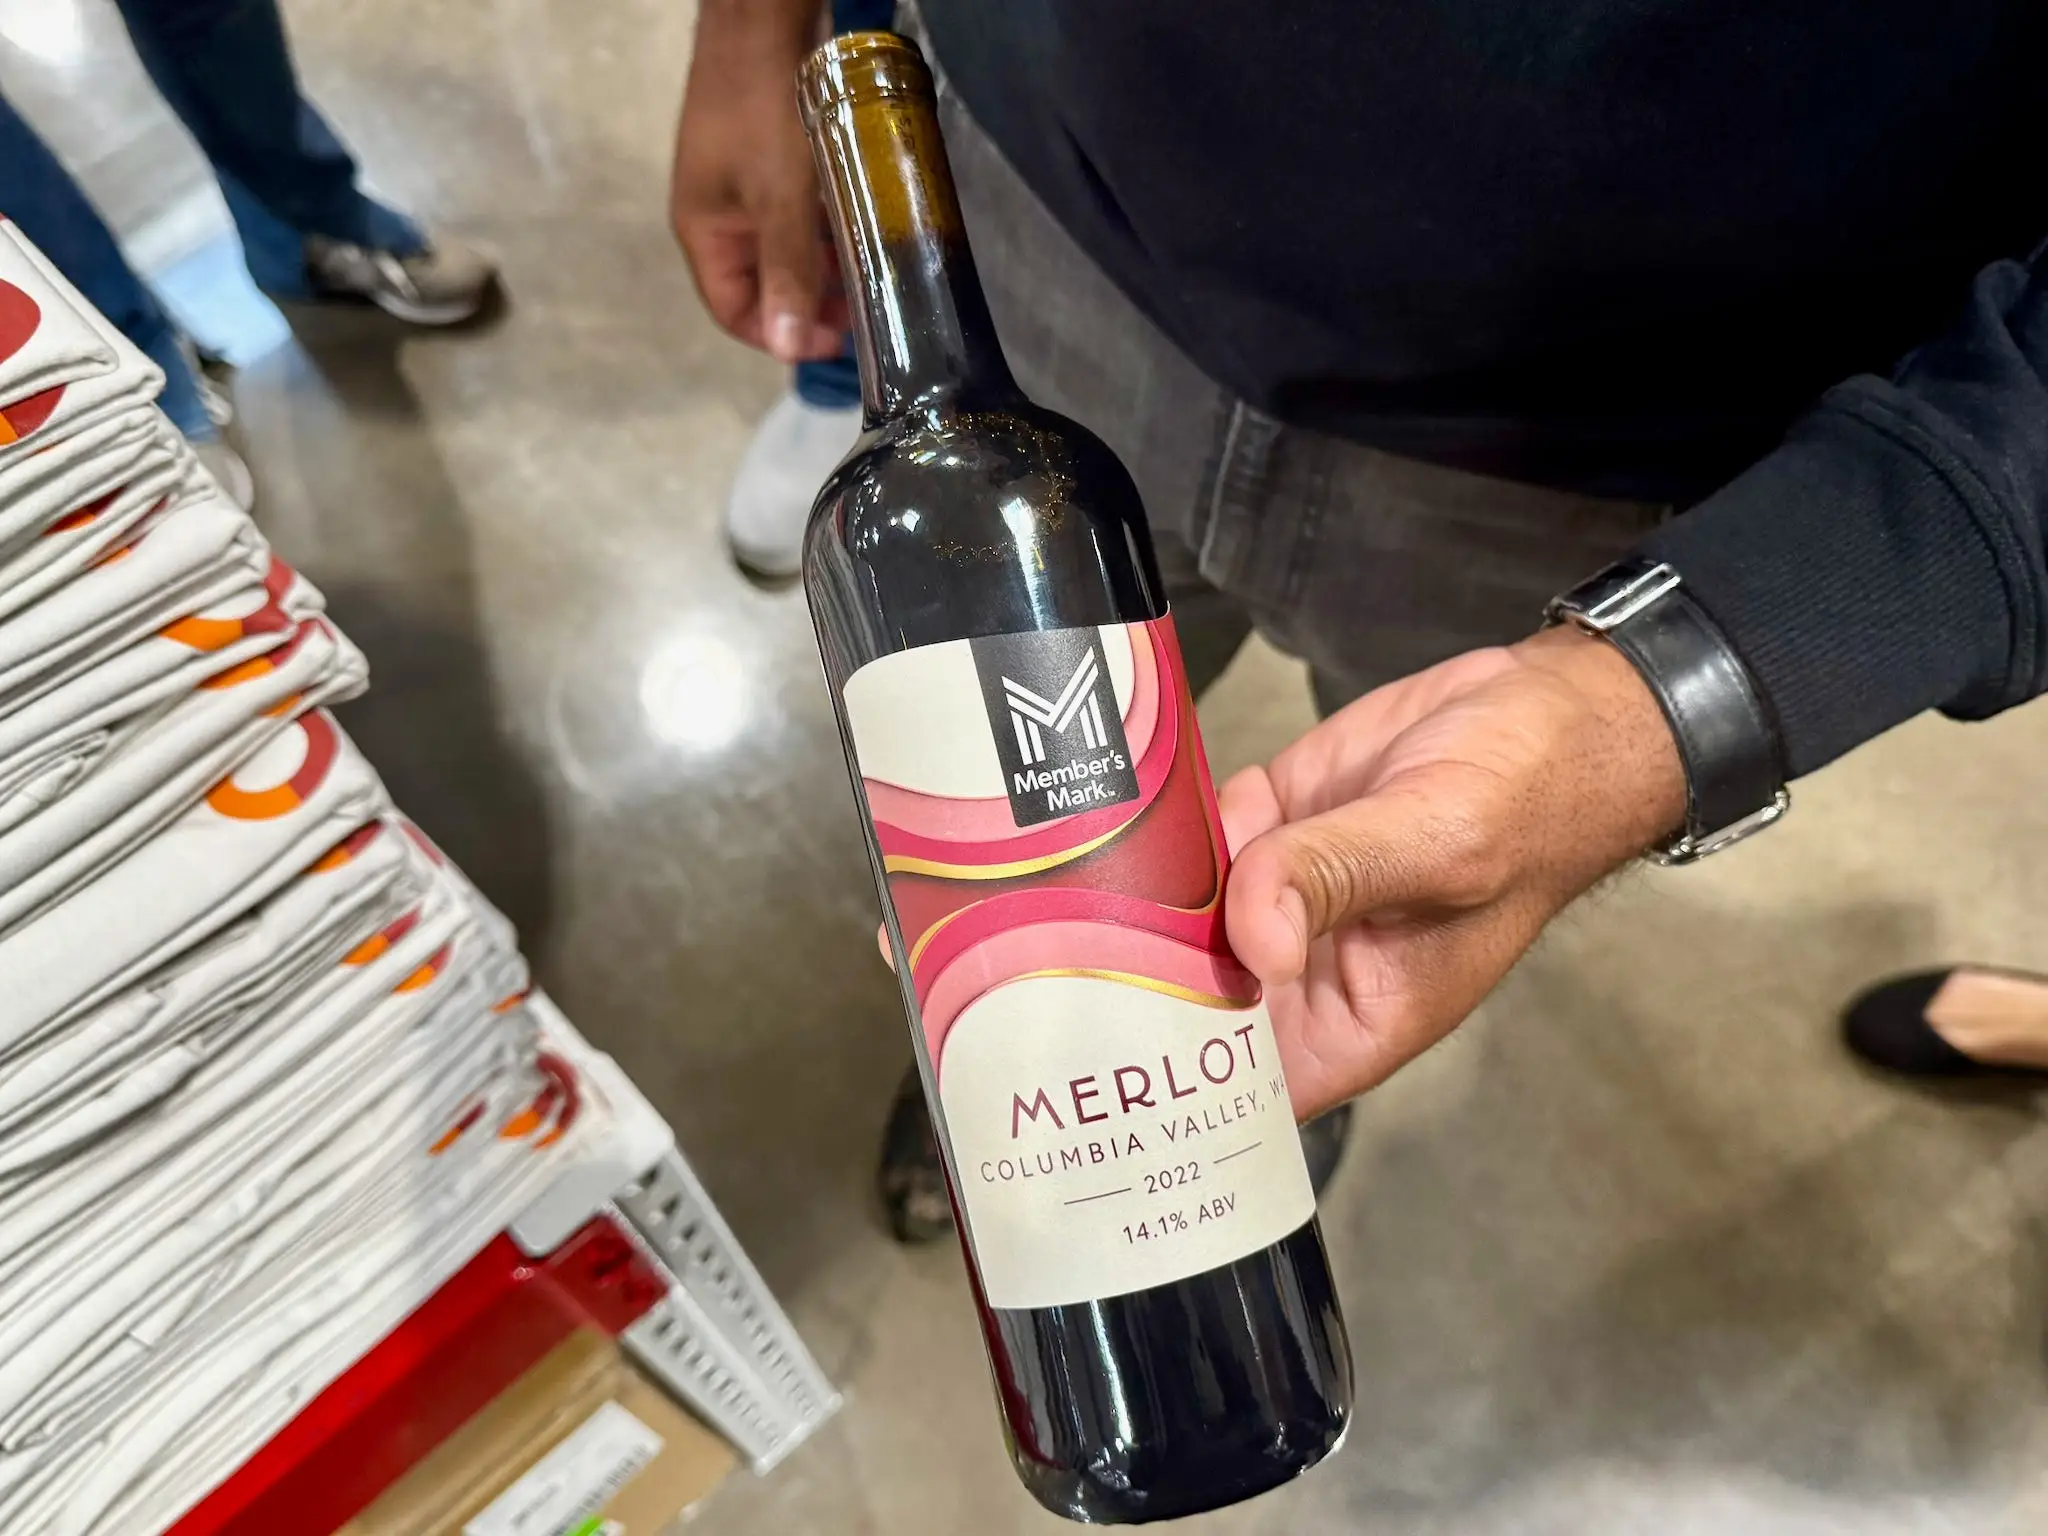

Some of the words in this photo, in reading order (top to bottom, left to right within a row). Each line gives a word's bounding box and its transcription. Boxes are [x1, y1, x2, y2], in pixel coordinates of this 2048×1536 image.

[1013, 750, 1126, 795] Member's
[1011, 1024, 1256, 1139] MERLOT
[980, 1132, 1145, 1182] COLUMBIA
[1160, 1090, 1266, 1143] VALLEY,
[1144, 1161, 1200, 1194] 2022
[1123, 1211, 1188, 1245] 14.1%
[1198, 1192, 1236, 1224] ABV
